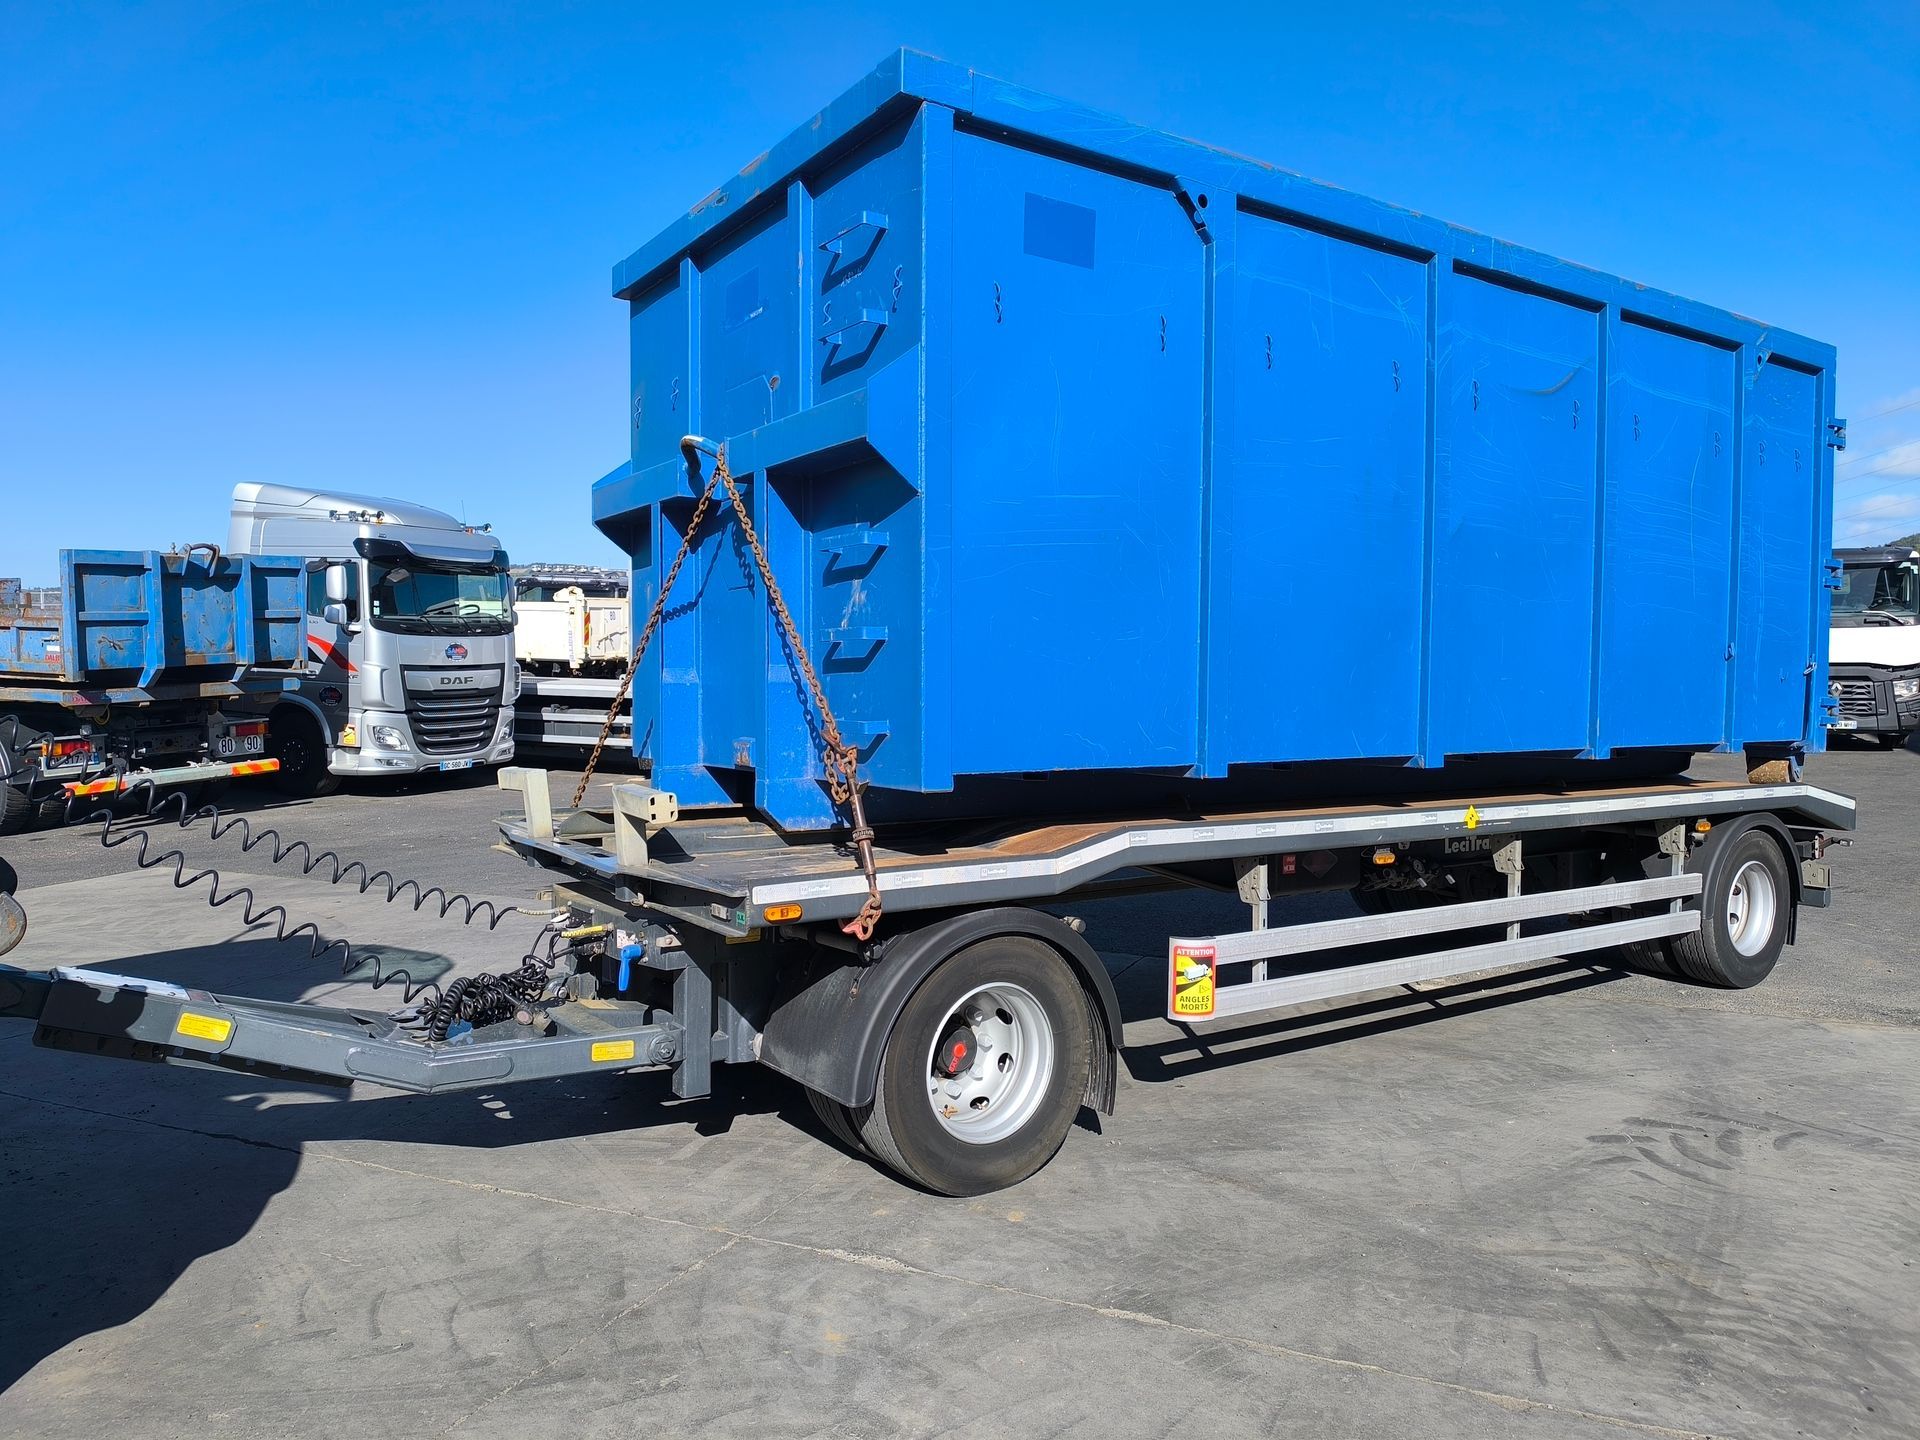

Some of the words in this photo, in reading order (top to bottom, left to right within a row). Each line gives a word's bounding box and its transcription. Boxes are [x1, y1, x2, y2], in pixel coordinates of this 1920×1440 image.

[440, 676, 474, 685] DAF
[221, 739, 233, 753] 80
[246, 736, 258, 750] 90
[1444, 835, 1491, 854] LeciTra
[1177, 948, 1214, 956] ATTENTION
[1180, 995, 1210, 1003] ANGLES
